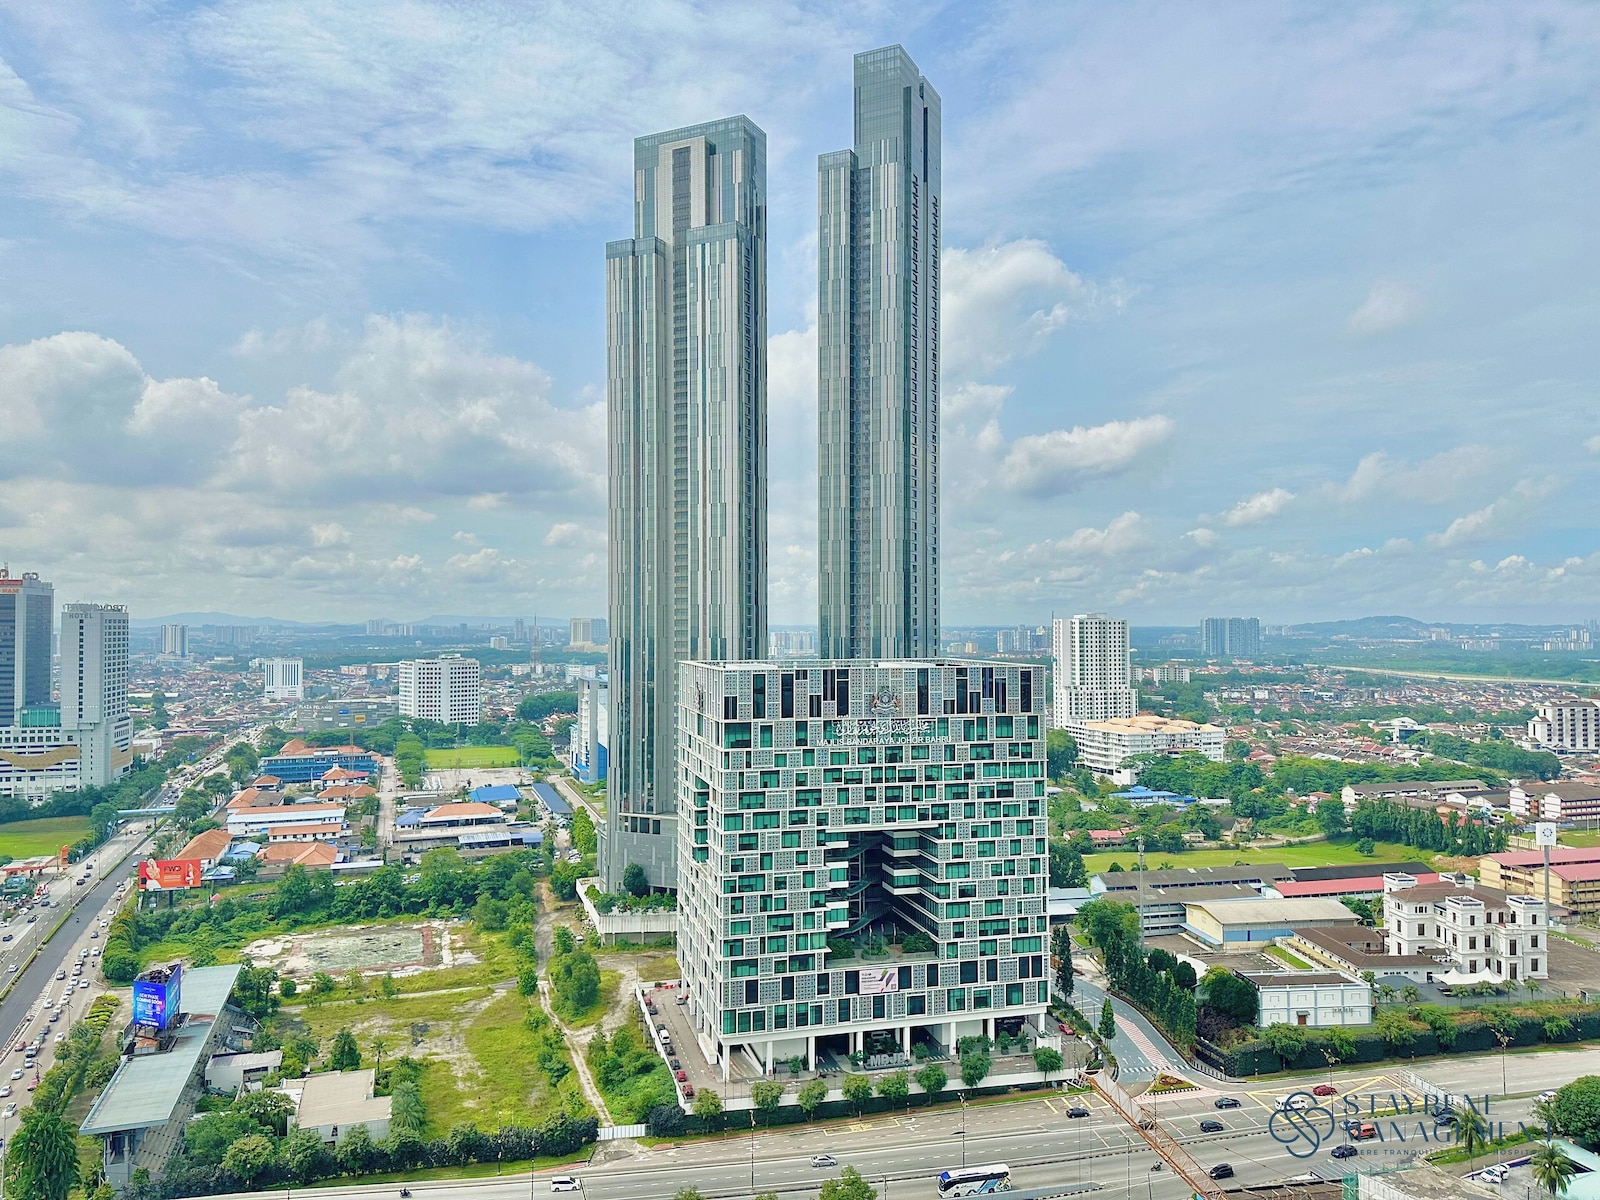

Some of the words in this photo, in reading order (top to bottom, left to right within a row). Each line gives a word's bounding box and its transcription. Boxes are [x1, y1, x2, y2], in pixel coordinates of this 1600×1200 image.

[817, 738, 844, 746] MAJLIS
[847, 737, 895, 746] BANDARAYA
[897, 736, 925, 744] JOHOR
[926, 735, 951, 743] BAHRU
[870, 1052, 905, 1067] MBJB
